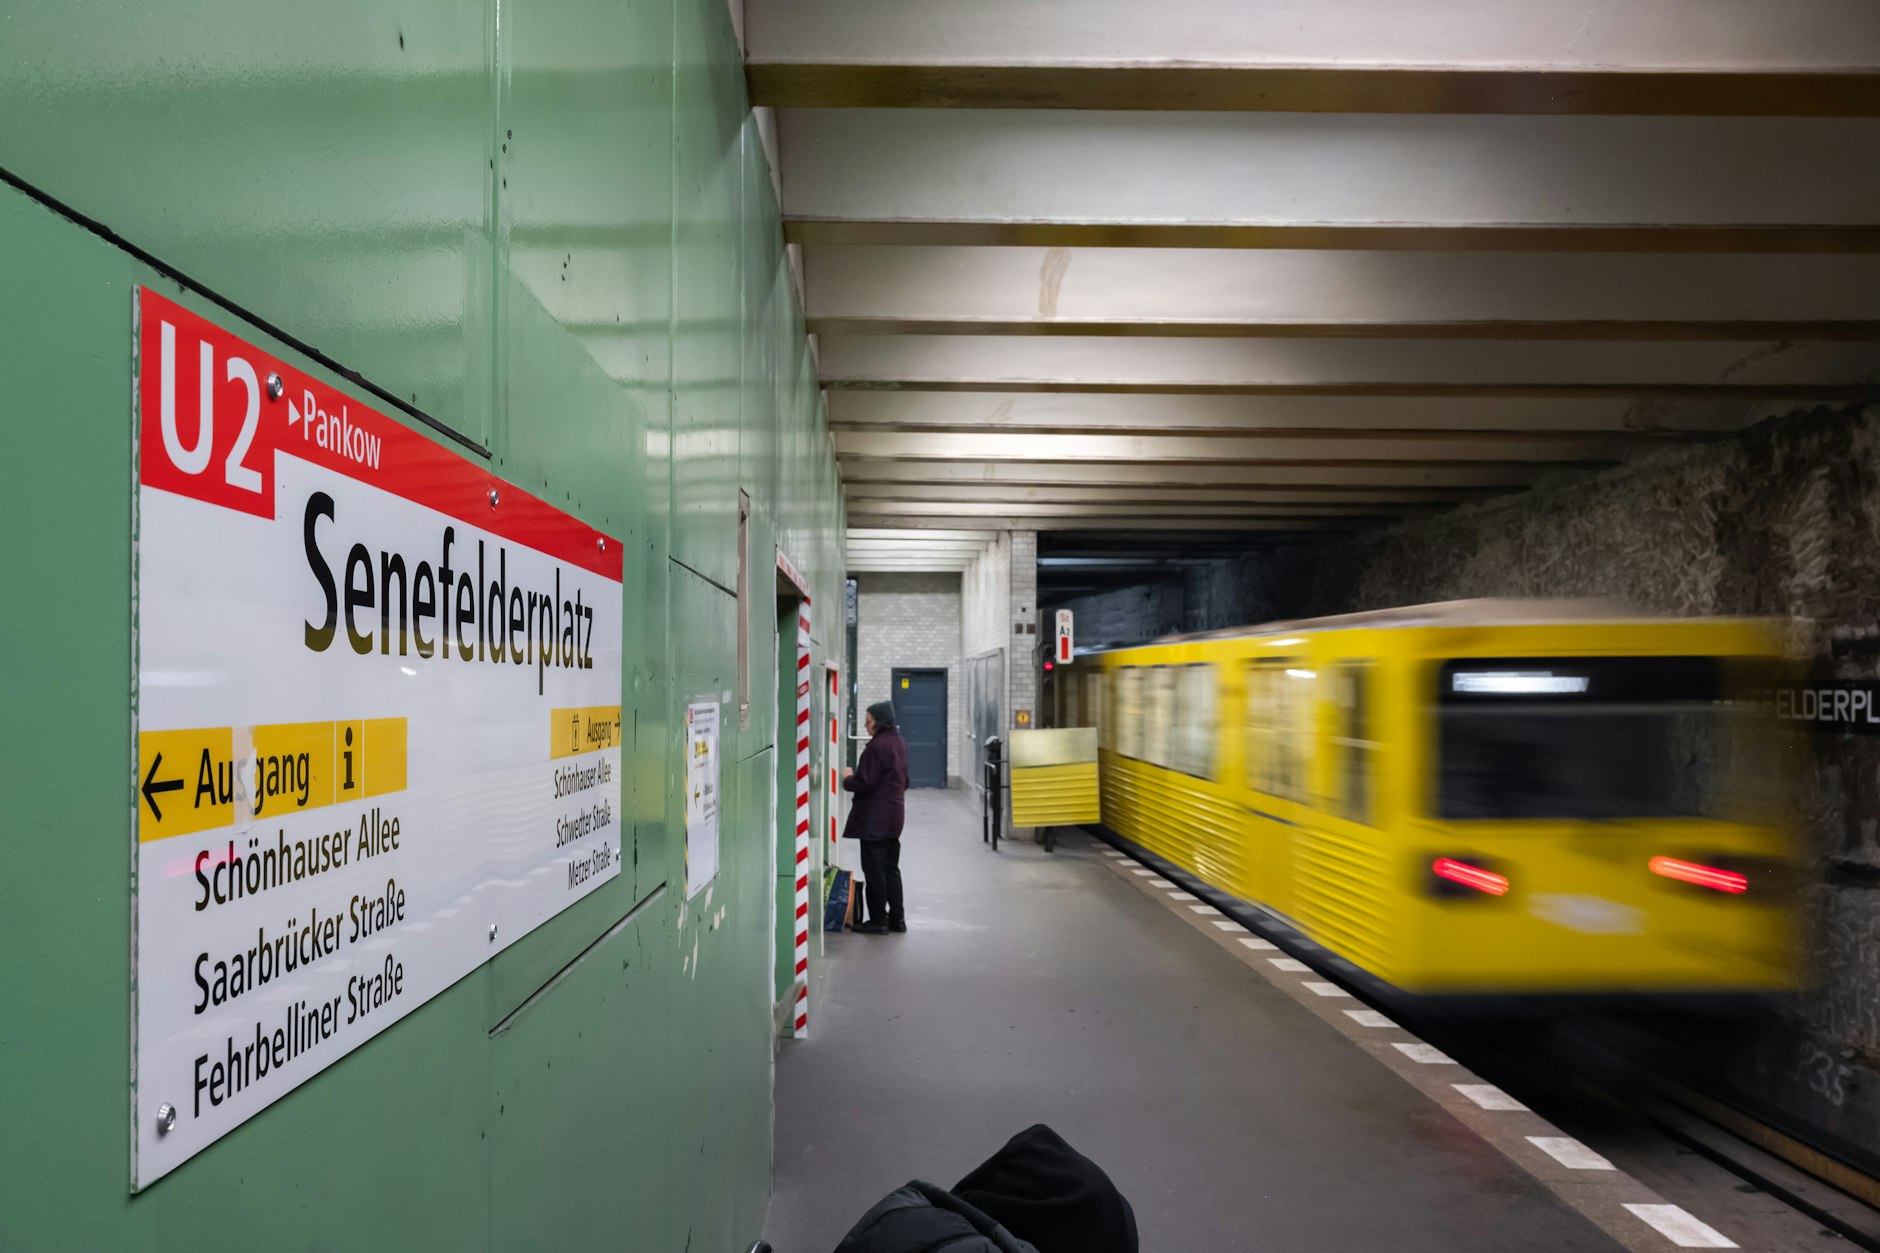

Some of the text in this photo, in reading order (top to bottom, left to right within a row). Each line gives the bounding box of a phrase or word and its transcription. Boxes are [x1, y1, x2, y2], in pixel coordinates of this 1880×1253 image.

[160, 319, 263, 495] U2
[303, 388, 382, 471] Pankow
[303, 490, 594, 696] Senefelderplatz
[554, 756, 612, 800] Schönhauser Allee
[586, 716, 612, 750] Ausgang
[194, 807, 400, 912] Schönhauser Allee
[556, 798, 612, 849] Schwedter Straße
[567, 840, 612, 892] Metzer Straße
[194, 877, 406, 1016] Saarbrücker Straße
[194, 953, 404, 1119] Fehrbelliner Straße
